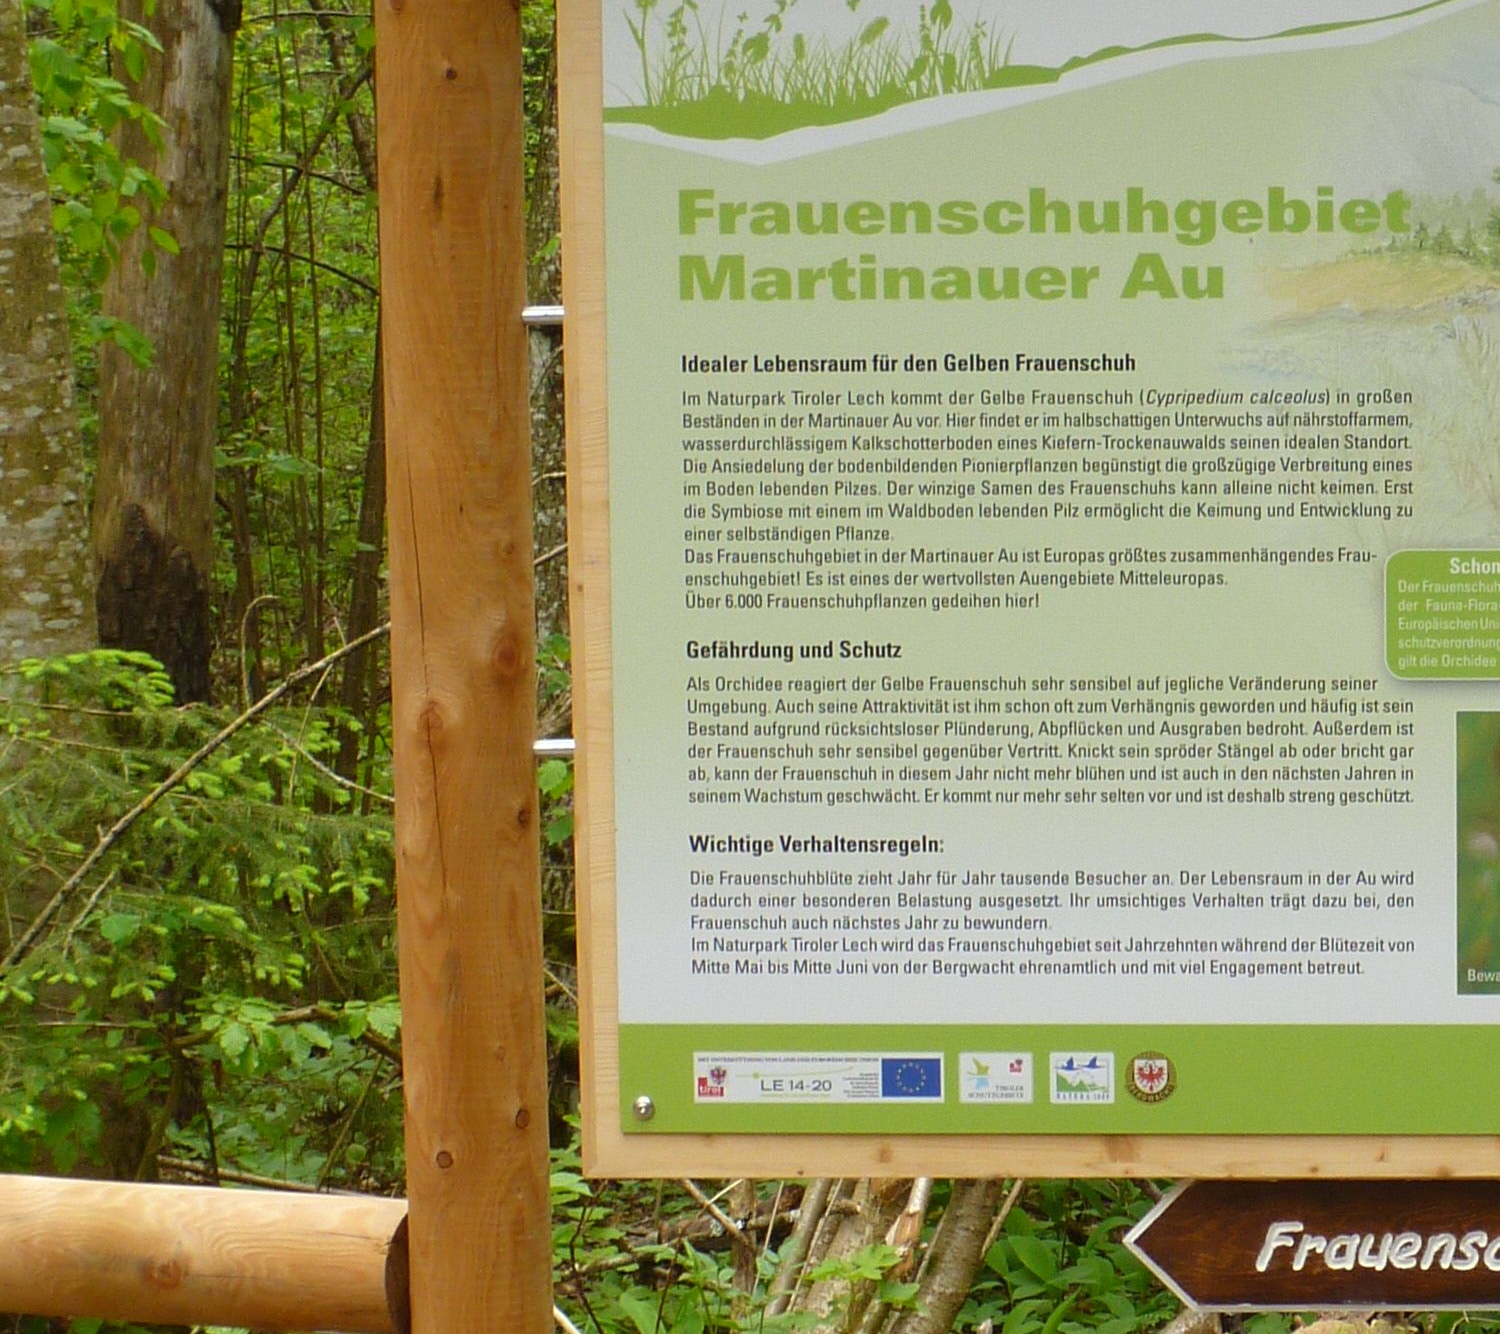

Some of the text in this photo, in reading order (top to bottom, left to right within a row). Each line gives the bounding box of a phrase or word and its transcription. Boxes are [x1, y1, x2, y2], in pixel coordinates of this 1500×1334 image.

[679, 187, 1412, 246] Frauenschuhgebiet
[679, 252, 1224, 301] Martinauer Au
[681, 353, 1136, 372] Idealer Lebensraum für den Gelben Frauenschuh
[682, 389, 1413, 409] Im Naturpark Tiroler Lech kommt der Gelbe Frauenschuh (Cypripedium calceolus) in großen
[1449, 557, 1500, 574] Schon
[685, 593, 1039, 612] Über 6.000 Frauenschuhpflanzen gedeihen hier!
[686, 641, 902, 662] Gefährdung und Schutz
[689, 835, 947, 856] Wichtige Verhaltensregeln:
[691, 959, 1365, 979] Mitte Mai bis Mitte Juni von der Bergwacht ehrenamtlich und mit viel Engagement betreut.
[760, 1079, 784, 1092] LE
[789, 1079, 832, 1092] 14-20
